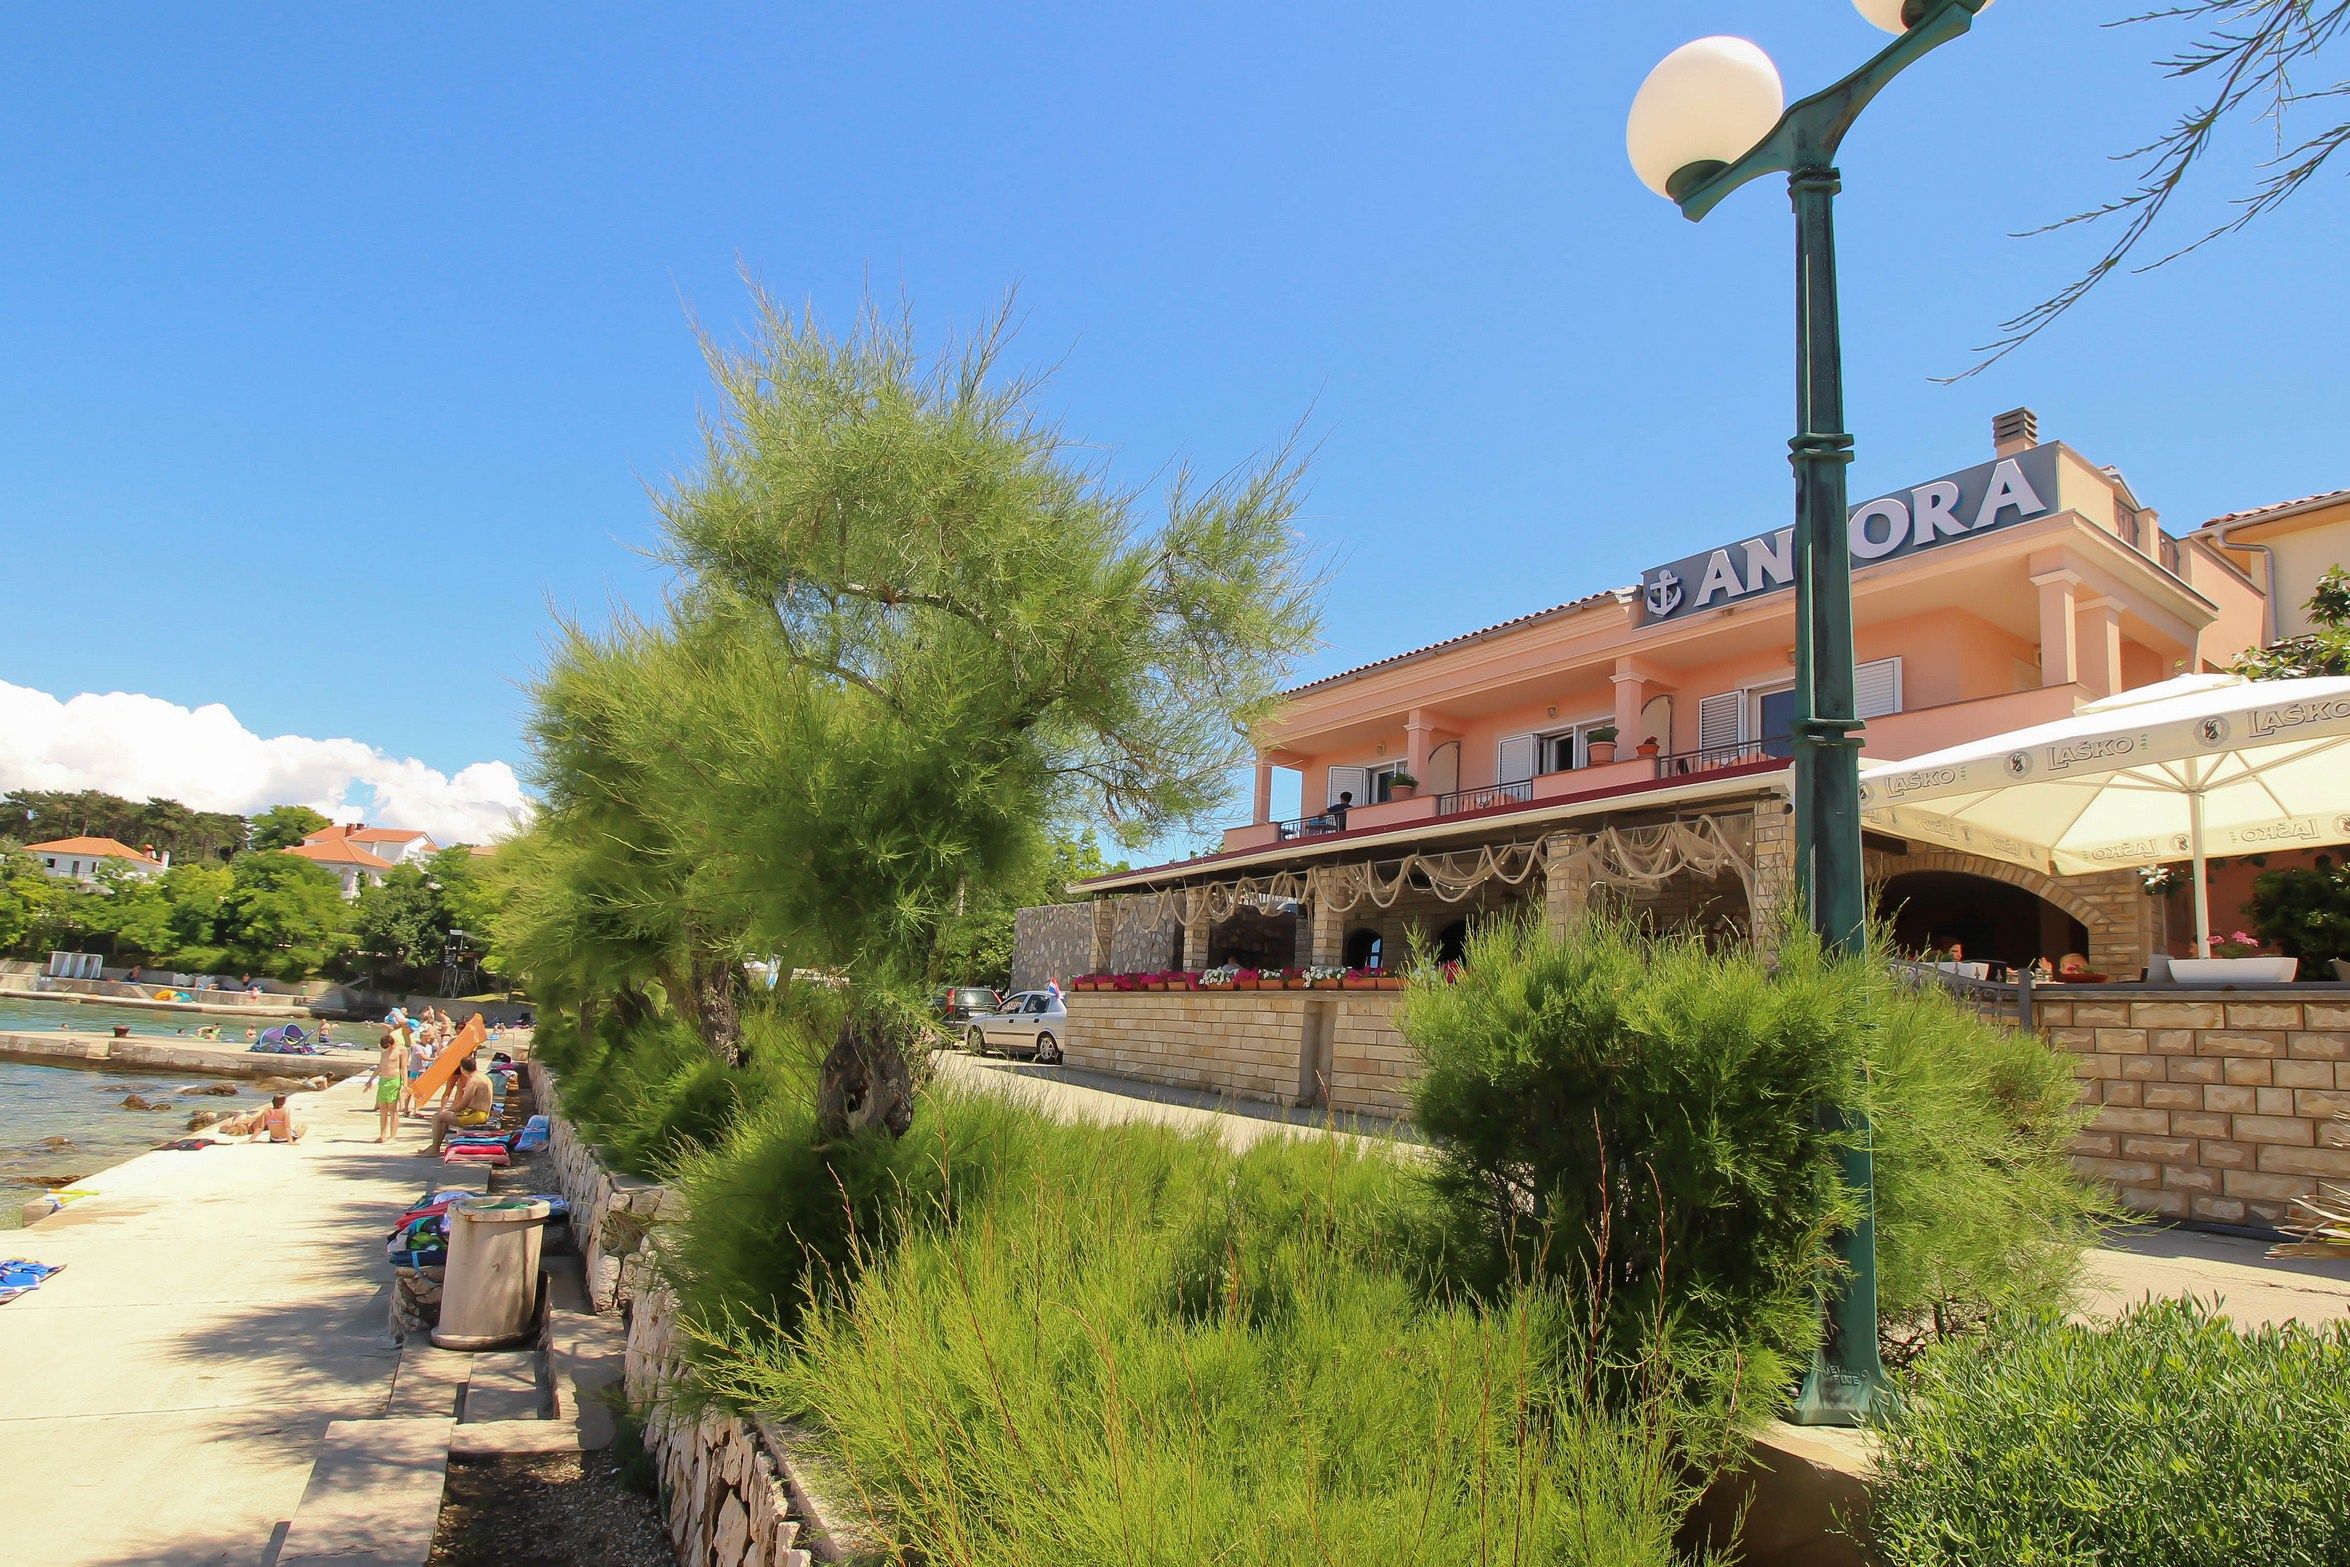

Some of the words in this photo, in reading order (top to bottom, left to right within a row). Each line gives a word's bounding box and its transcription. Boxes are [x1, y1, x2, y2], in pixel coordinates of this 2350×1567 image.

[1693, 458, 2047, 608] ANORA
[2246, 699, 2350, 738] LAŠKO
[2047, 736, 2134, 770] LAŠKO
[1884, 769, 1956, 798] LAŠKO
